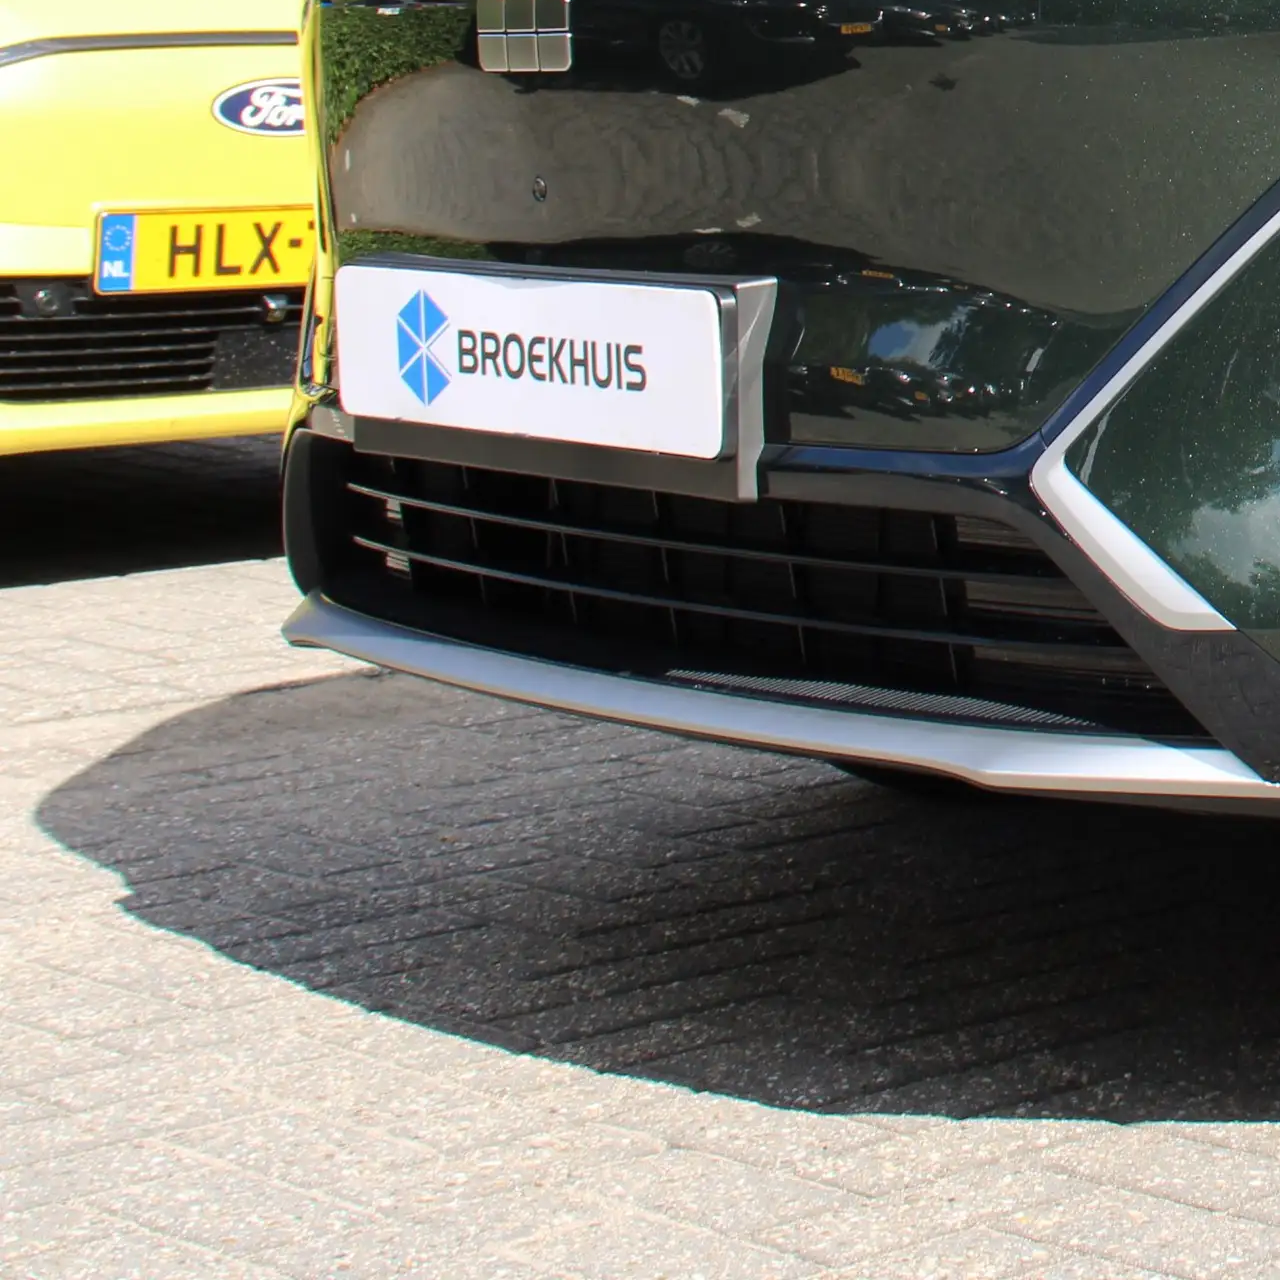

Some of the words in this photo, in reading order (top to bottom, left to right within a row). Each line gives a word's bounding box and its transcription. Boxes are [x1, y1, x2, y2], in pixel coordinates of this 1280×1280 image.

[241, 86, 304, 127] For
[102, 261, 130, 278] NL
[167, 221, 315, 277] HLX-
[457, 329, 647, 392] BROEKHUIS
